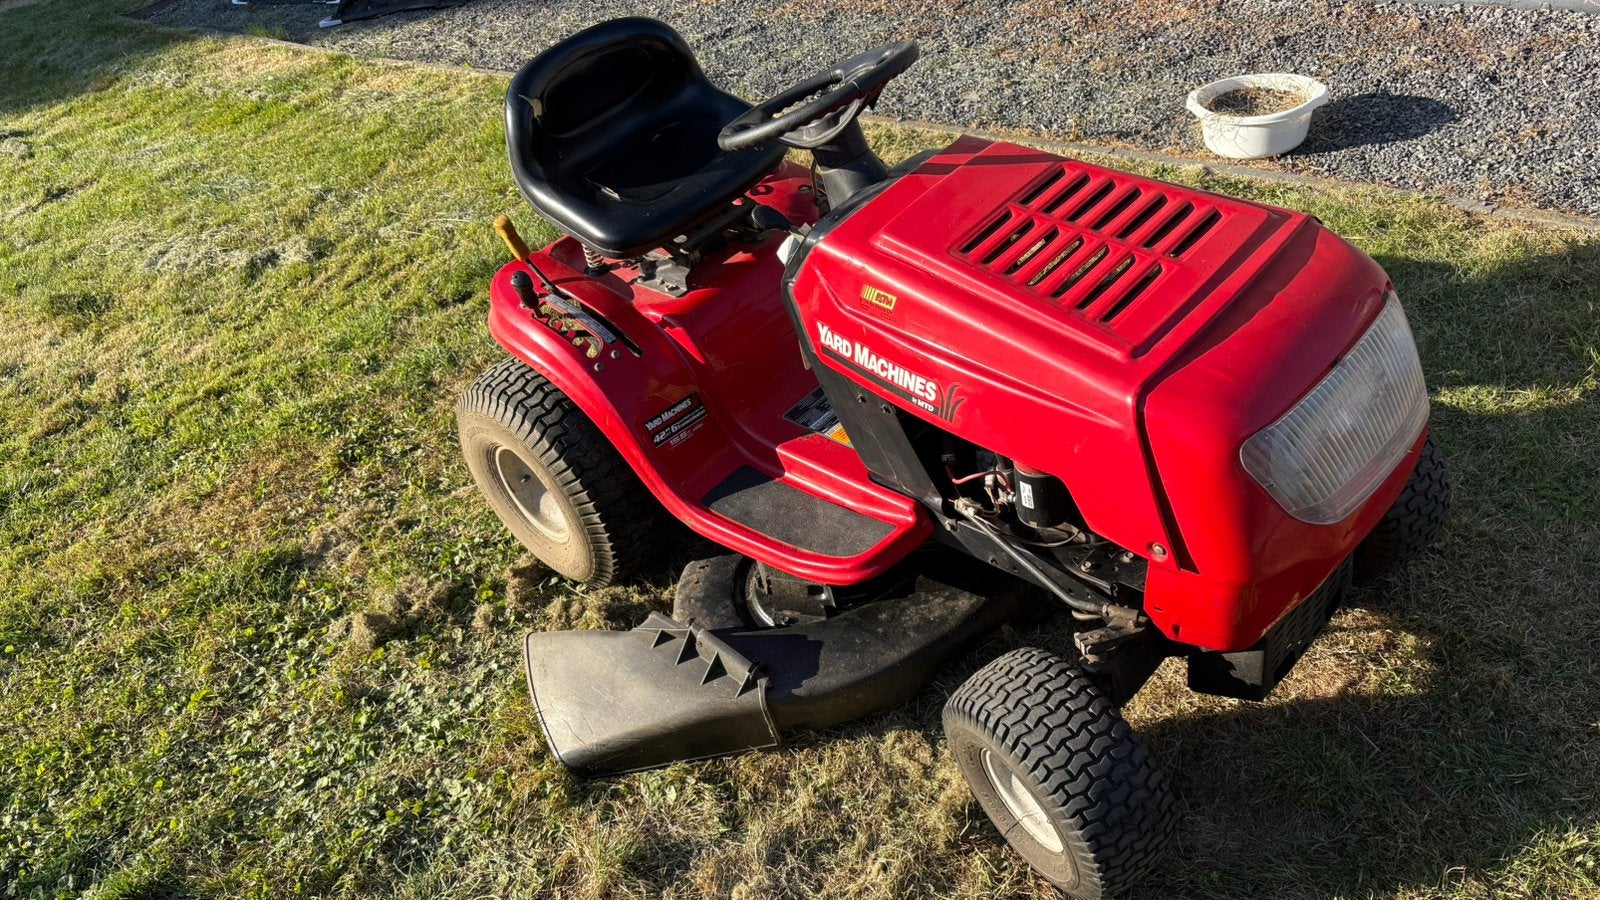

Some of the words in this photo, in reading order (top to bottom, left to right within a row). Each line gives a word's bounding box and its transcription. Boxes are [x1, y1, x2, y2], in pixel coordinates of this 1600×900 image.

[816, 321, 852, 358] YARD
[854, 343, 937, 401] MACHINES
[645, 417, 662, 431] YARD
[661, 398, 692, 422] MACHINES
[918, 399, 934, 412] MTD
